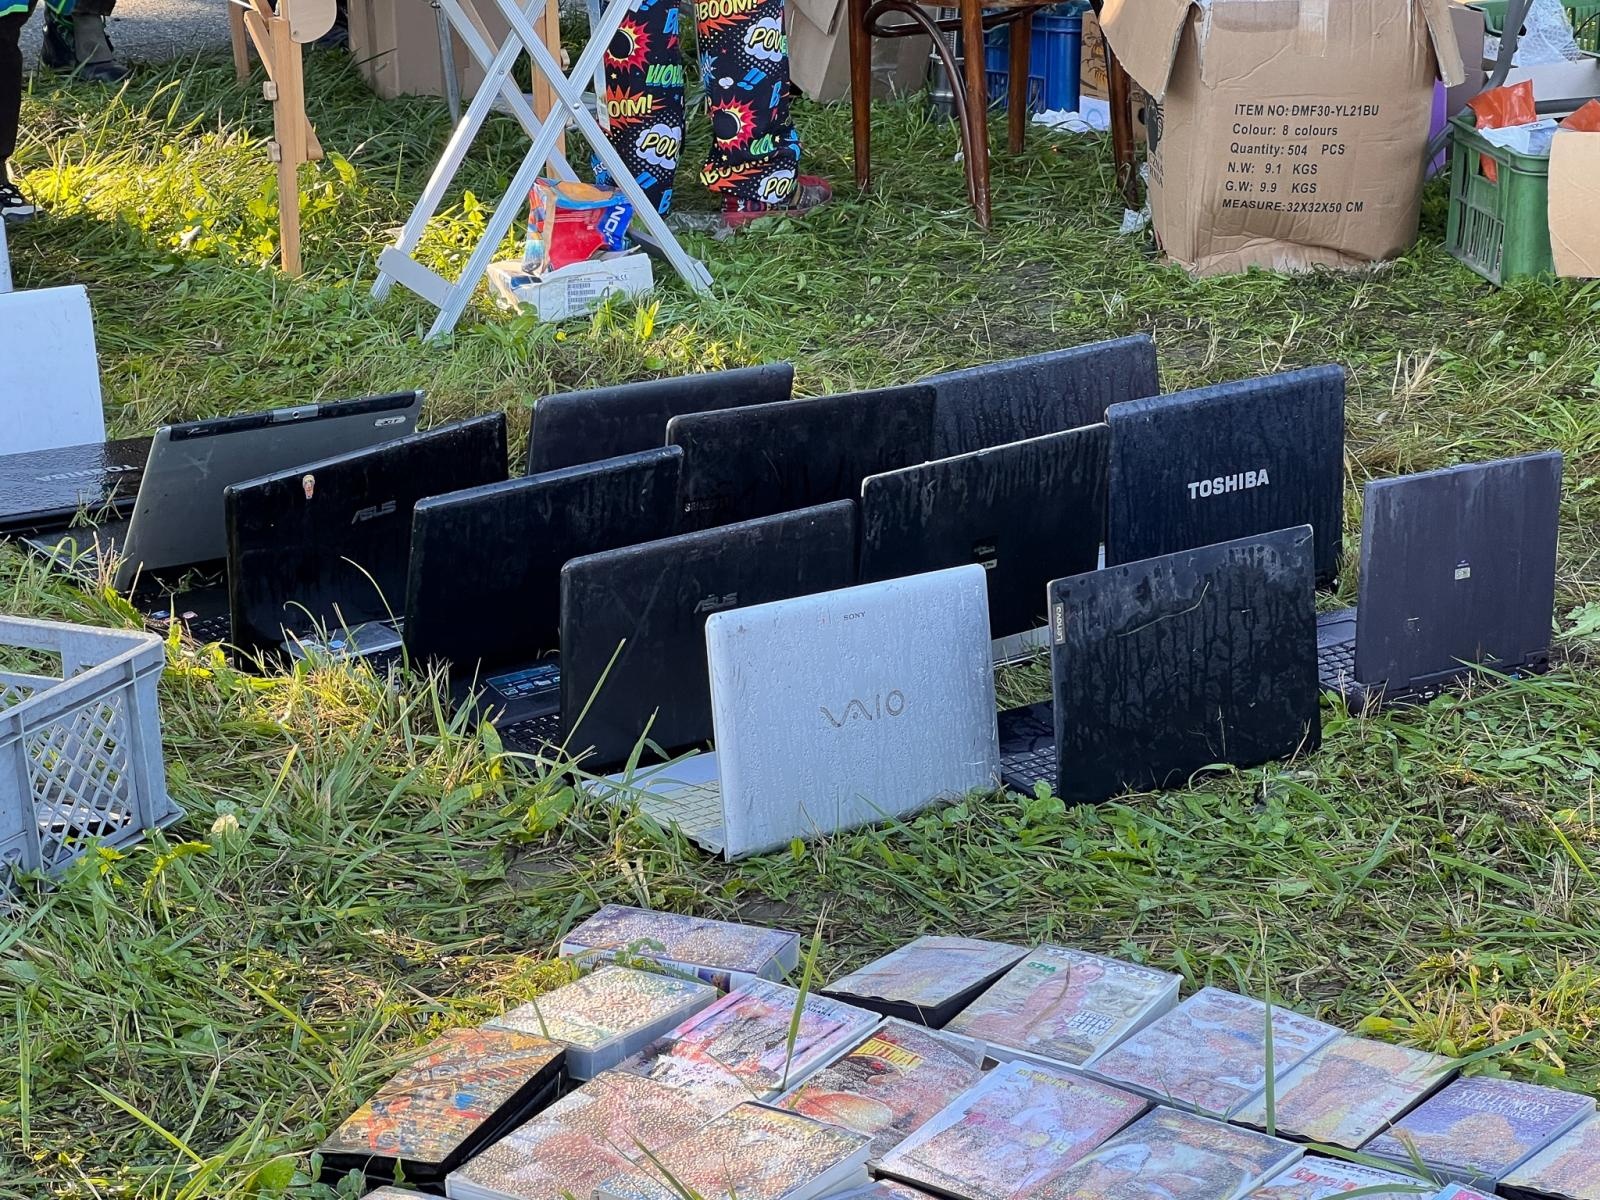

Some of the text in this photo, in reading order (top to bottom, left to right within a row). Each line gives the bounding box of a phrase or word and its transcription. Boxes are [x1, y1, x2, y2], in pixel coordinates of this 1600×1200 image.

[1234, 104, 1264, 116] ITEM
[1232, 124, 1338, 136] Colour: 8 colours
[1321, 144, 1346, 156] PCS
[1227, 163, 1318, 175] N.W: 9.1 KGS
[1225, 181, 1317, 194] G.W: 9.9 KGS
[1345, 201, 1363, 213] CM
[1188, 468, 1270, 500] TOSHIBA
[351, 501, 397, 525] ASUS
[843, 611, 866, 621] SONY
[820, 690, 904, 728] VAIO
